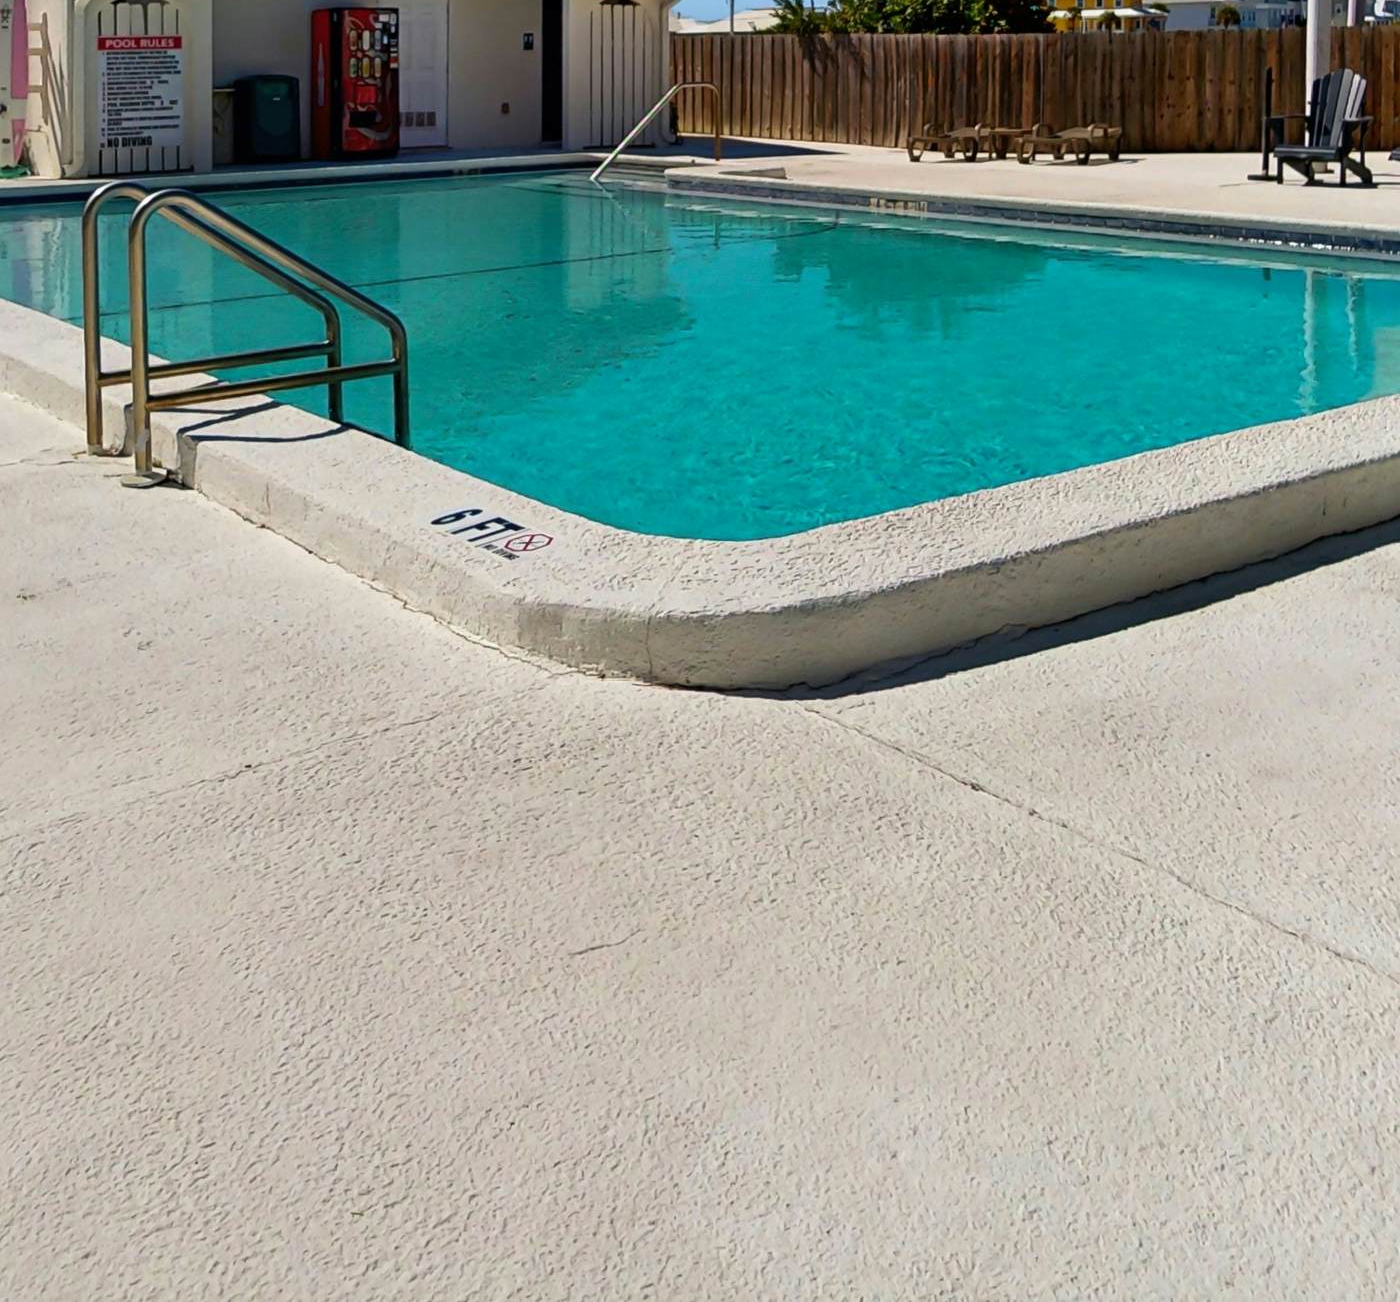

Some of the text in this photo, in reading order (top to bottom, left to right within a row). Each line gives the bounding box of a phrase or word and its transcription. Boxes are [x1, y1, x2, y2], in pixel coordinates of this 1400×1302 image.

[105, 38, 175, 48] POOL RULES
[107, 137, 119, 148] NO
[121, 135, 152, 147] DIVING
[430, 508, 526, 542] 6 FT
